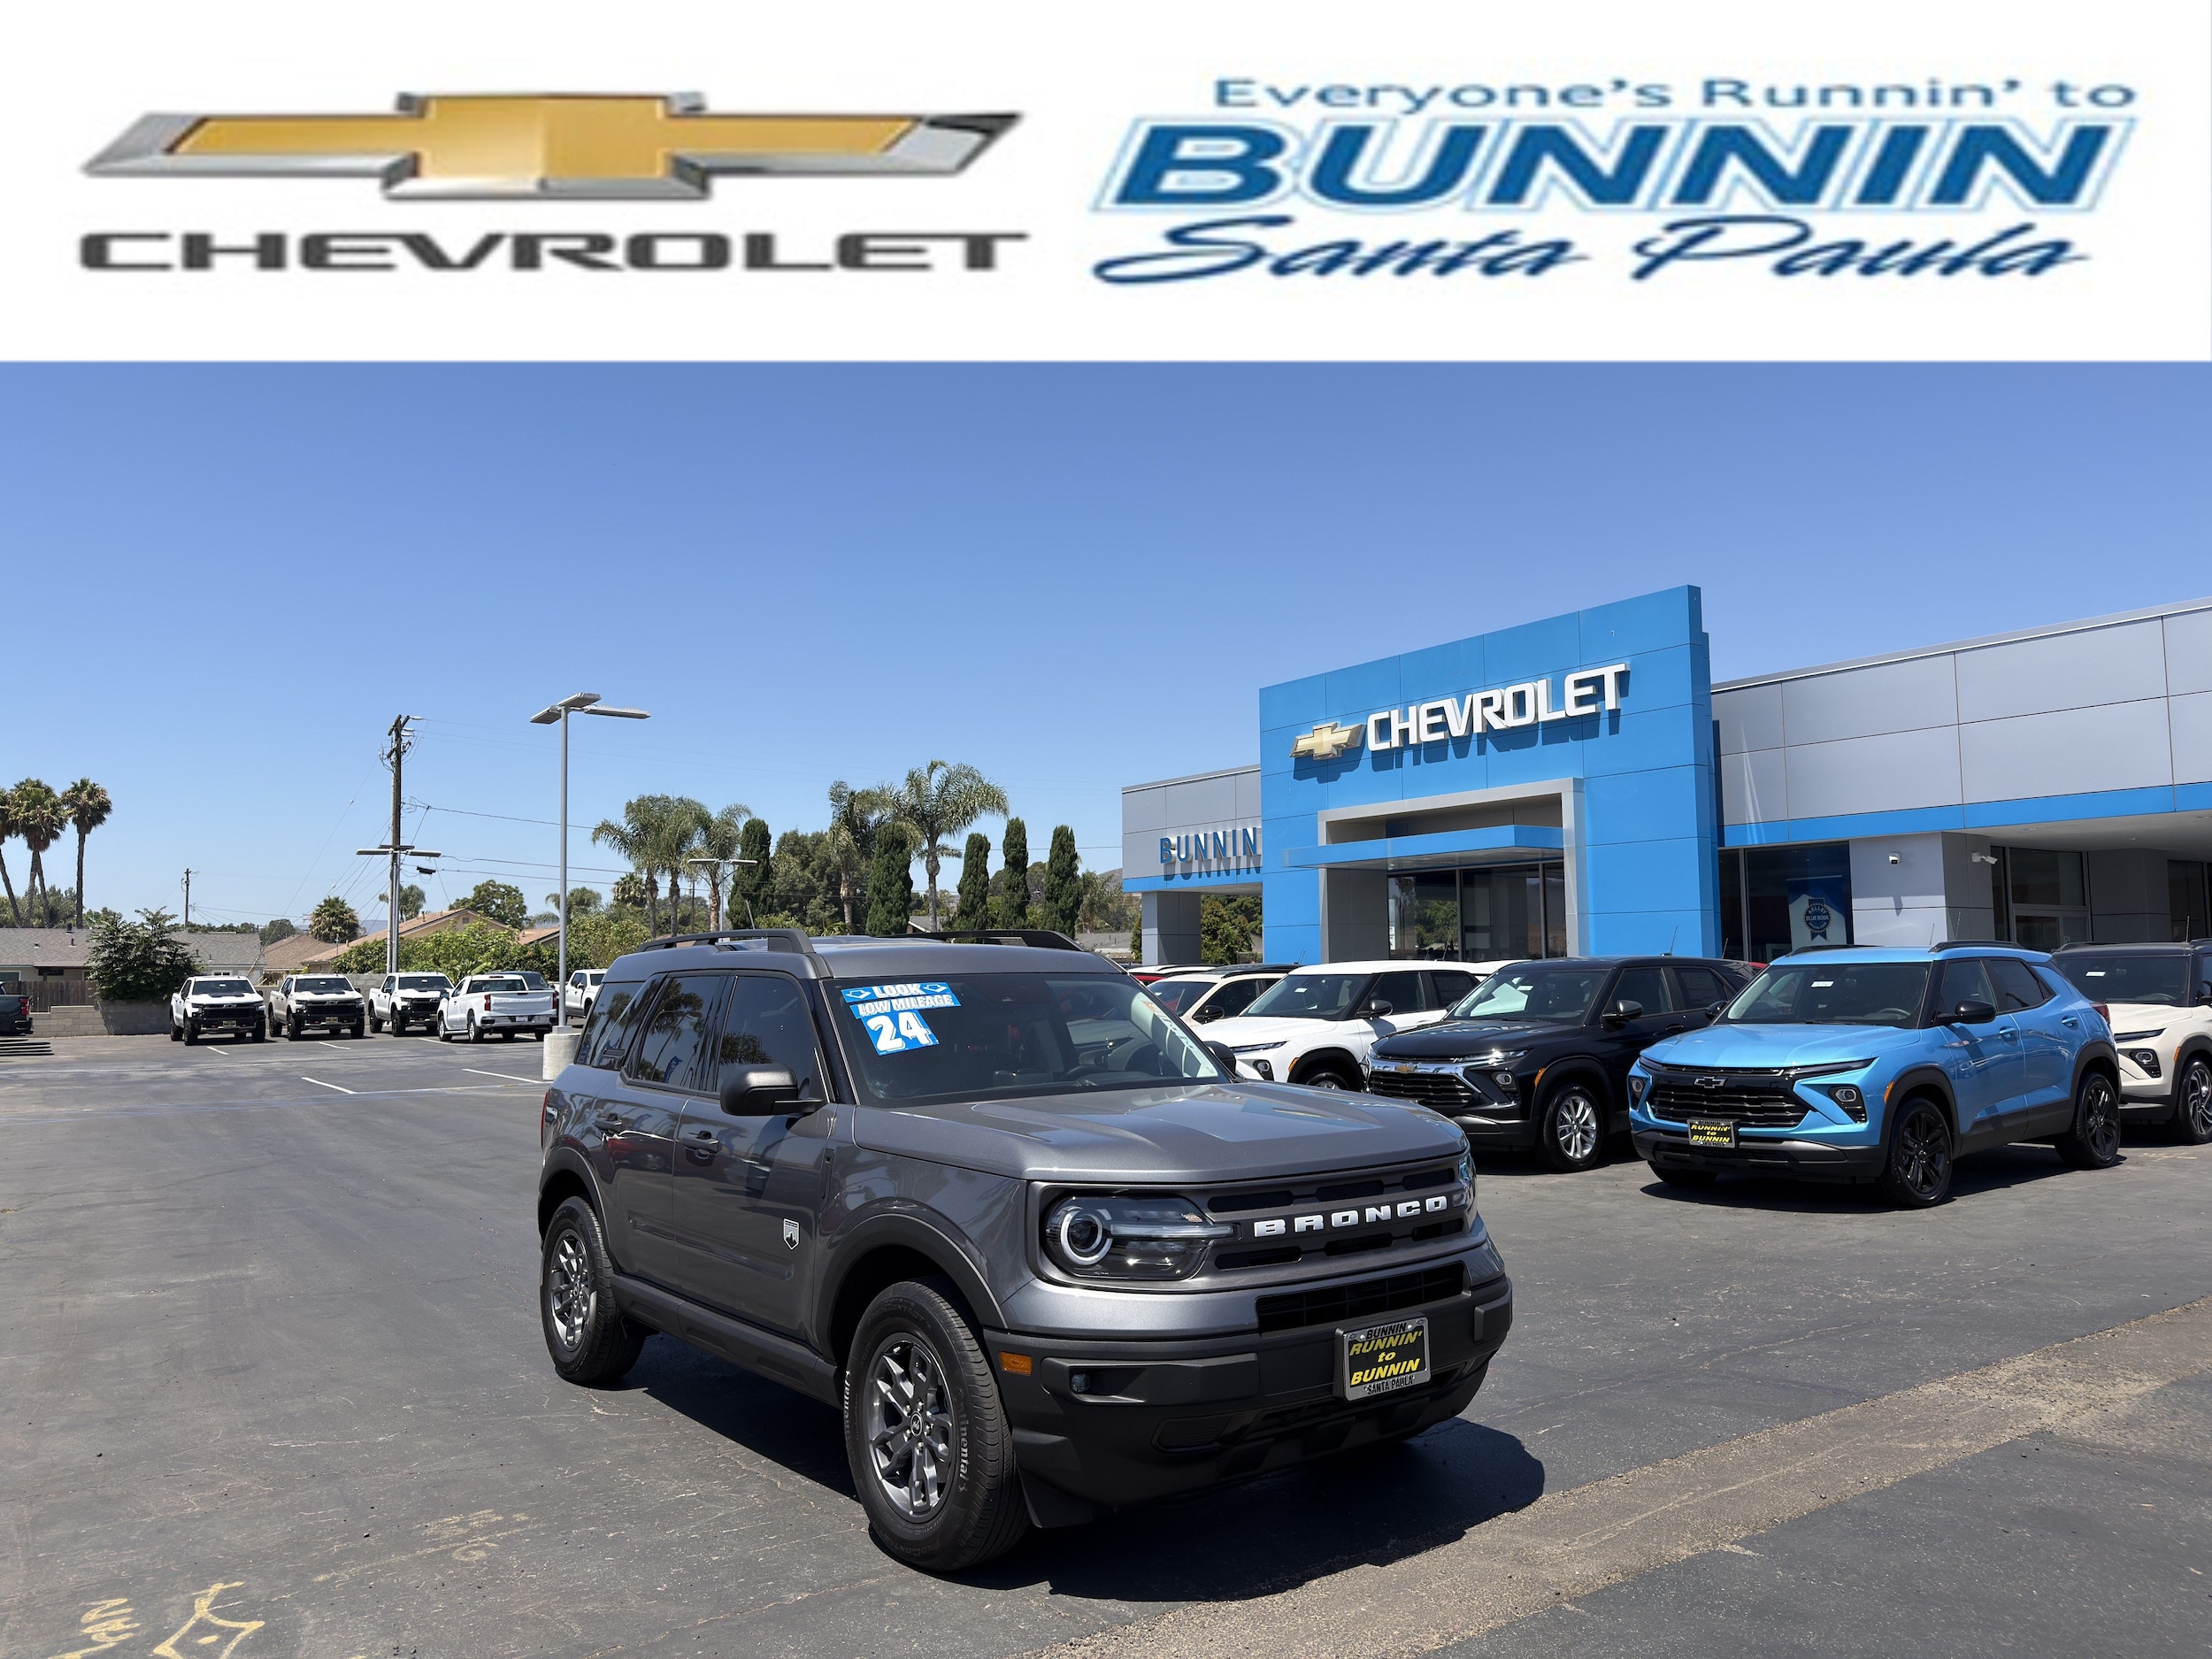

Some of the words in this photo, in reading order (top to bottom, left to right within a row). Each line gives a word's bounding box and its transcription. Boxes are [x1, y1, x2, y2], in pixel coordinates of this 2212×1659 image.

[1367, 663, 1629, 751] CHEVROLET
[1159, 826, 1259, 864] BUNNIN
[872, 983, 926, 998] LOOK
[857, 1000, 891, 1017] LOW
[891, 994, 955, 1011] MILEAGE
[867, 1011, 932, 1051] 24
[1254, 1195, 1448, 1238] BRONCO
[1349, 1331, 1423, 1356] RUNNIN'
[1366, 1322, 1408, 1340] BUNNIN
[1378, 1351, 1396, 1363] to
[1350, 1357, 1421, 1386] BUNNIN
